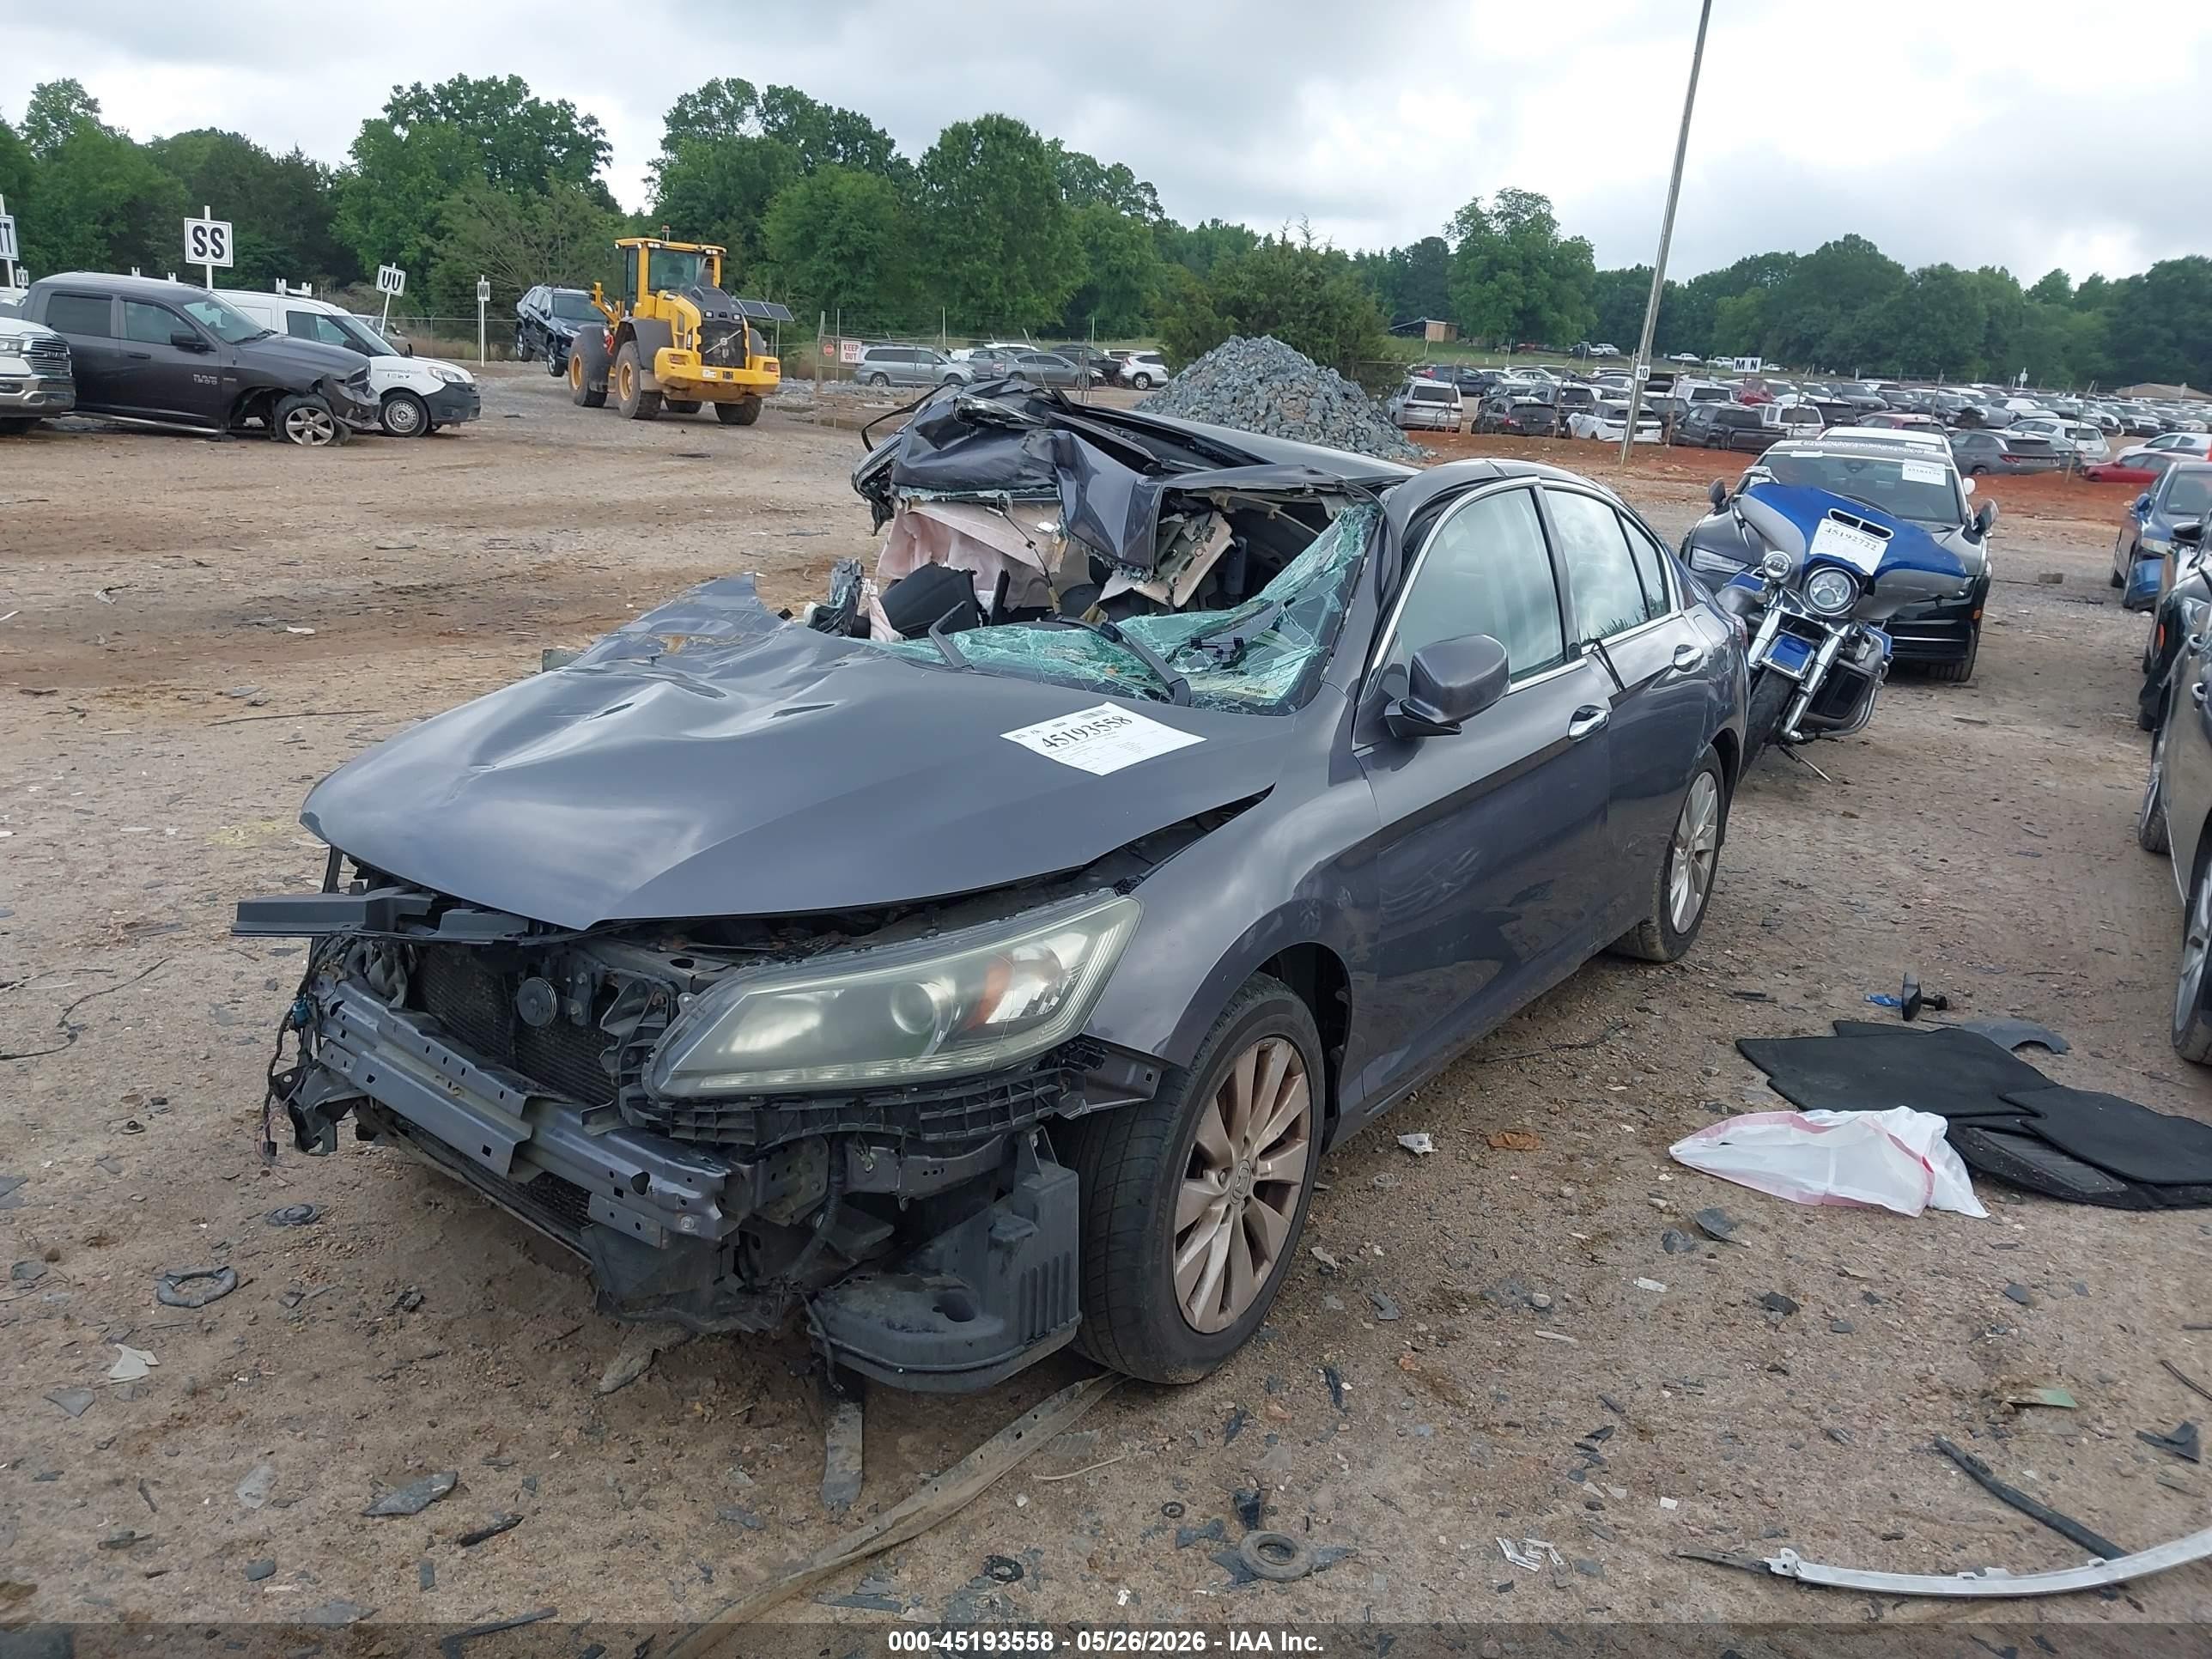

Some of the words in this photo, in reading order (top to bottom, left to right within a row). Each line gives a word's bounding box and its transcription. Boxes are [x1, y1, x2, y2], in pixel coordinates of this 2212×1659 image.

[192, 225, 224, 259] SS
[17, 272, 28, 283] XX
[382, 270, 402, 291] UU
[843, 343, 860, 352] KEEP
[845, 352, 857, 361] OUT
[1735, 359, 1745, 370] M
[1749, 360, 1759, 370] N
[1638, 368, 1648, 379] 10
[1825, 527, 1877, 551] 45192722
[1041, 714, 1133, 750] 45193558
